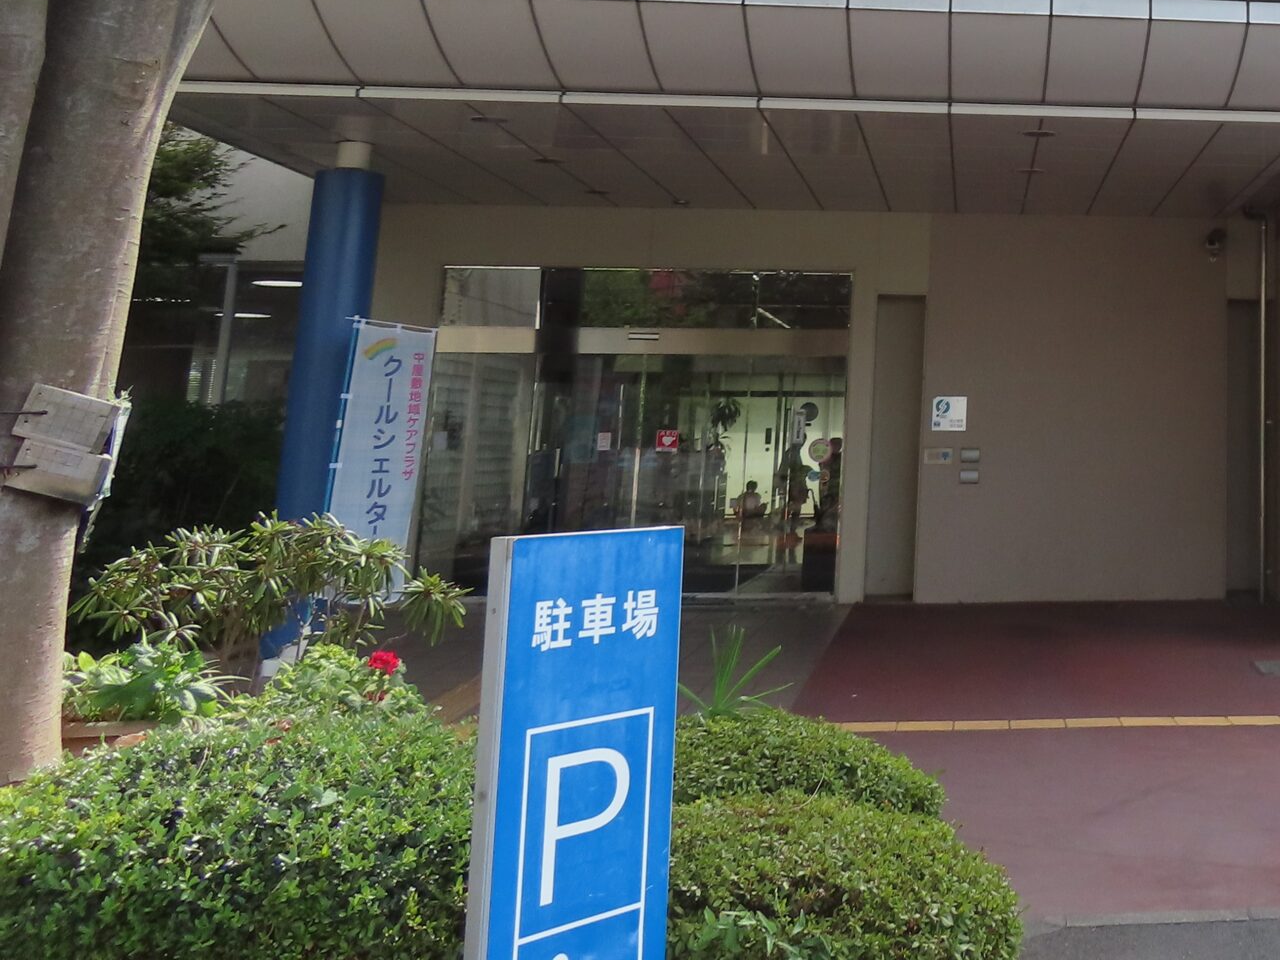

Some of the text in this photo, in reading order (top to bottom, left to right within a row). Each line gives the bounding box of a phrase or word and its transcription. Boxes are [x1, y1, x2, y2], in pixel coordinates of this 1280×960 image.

[532, 589, 659, 651] 駐車場
[540, 748, 630, 907] P
